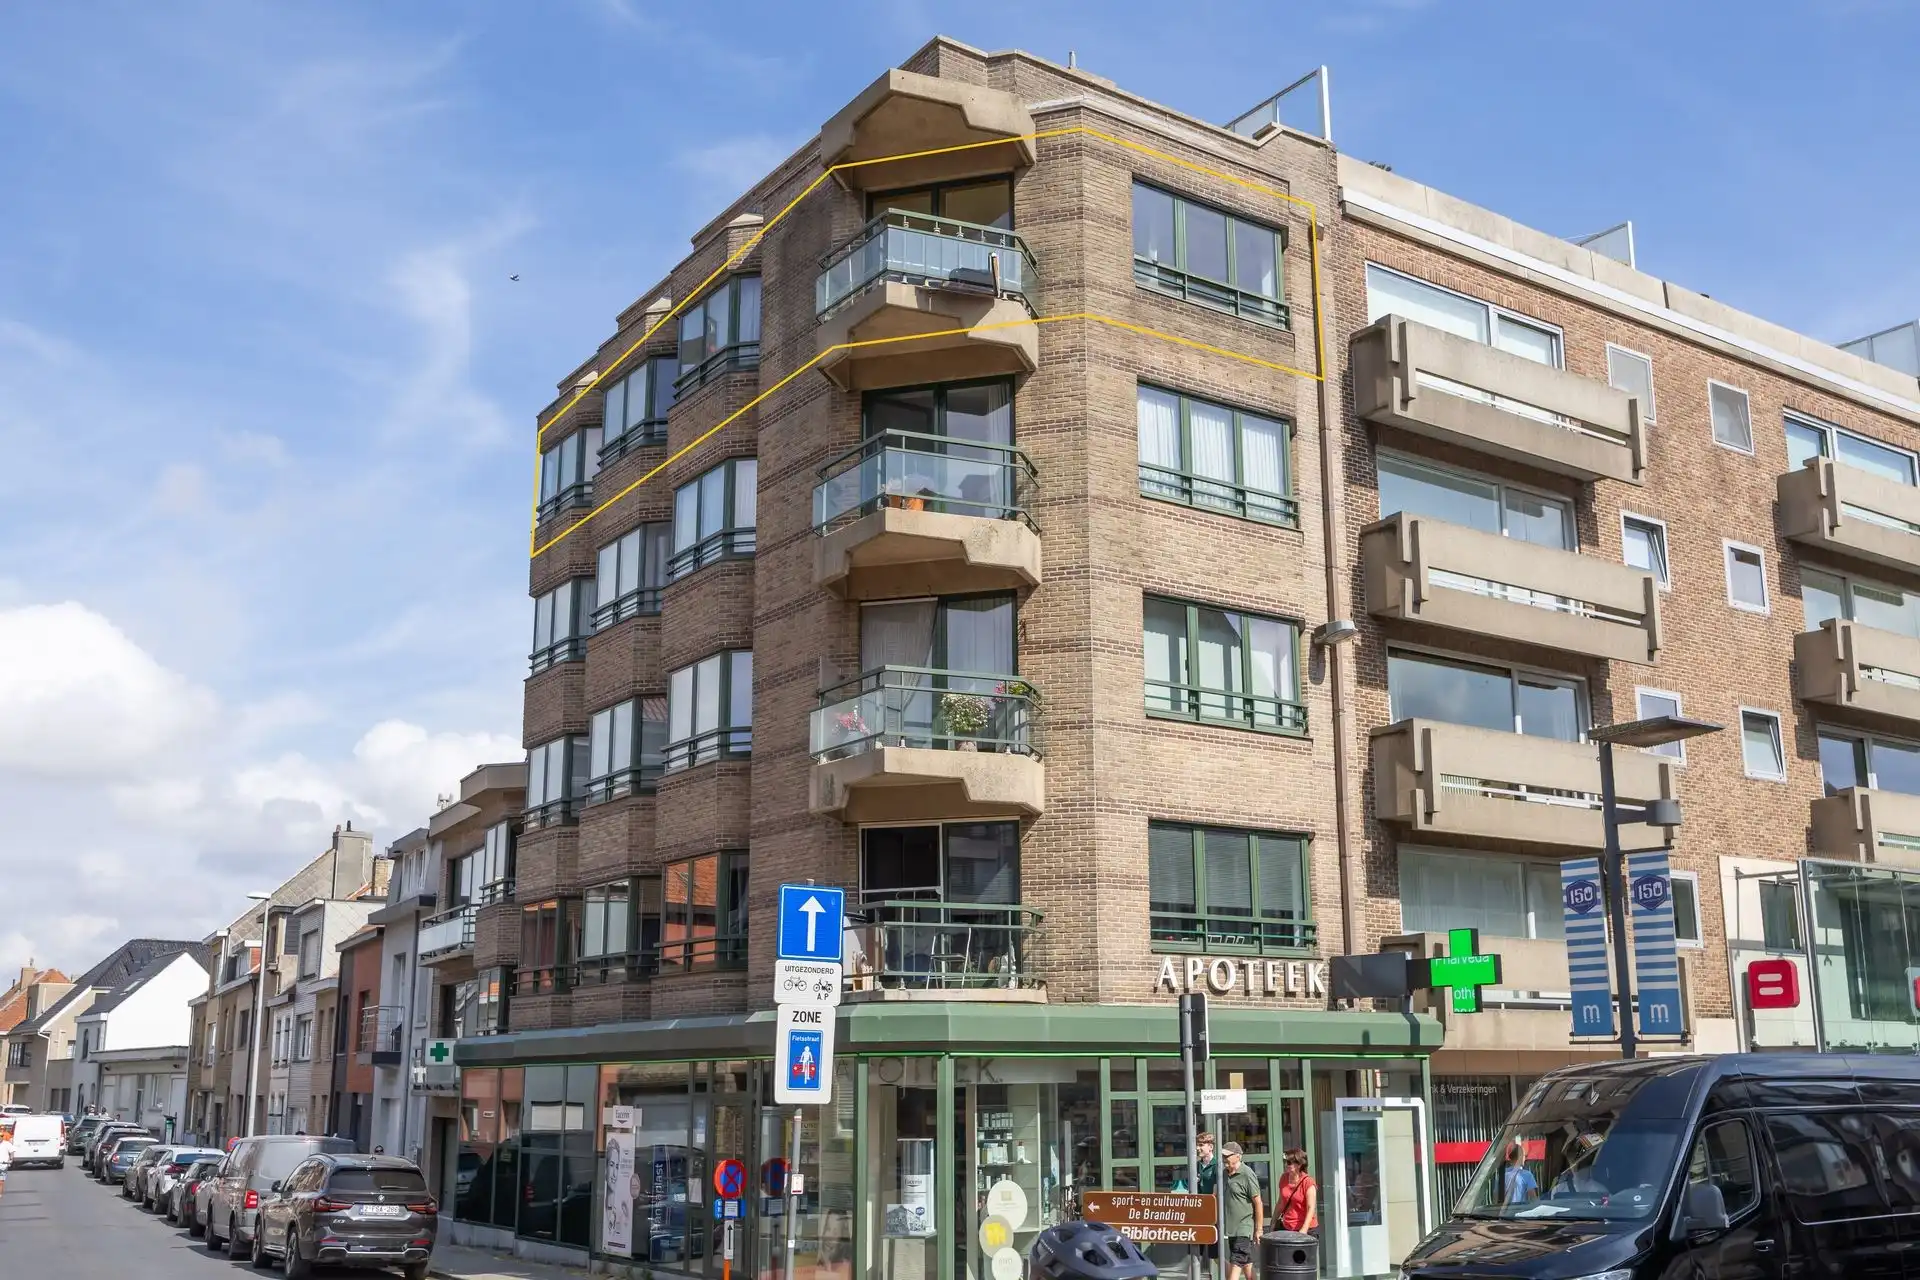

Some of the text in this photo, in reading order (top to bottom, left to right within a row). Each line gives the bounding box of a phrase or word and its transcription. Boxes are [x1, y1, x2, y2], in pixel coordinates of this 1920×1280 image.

[1570, 886, 1593, 904] 150
[1637, 881, 1663, 899] 150
[784, 965, 835, 975] UITGEZONDERD
[1154, 955, 1326, 997] APOTEEK
[792, 1011, 822, 1023] ZONE
[1440, 1084, 1447, 1094] &
[1447, 1084, 1497, 1096] Verzekeringen
[1153, 1196, 1203, 1208] cultuurhuis
[1128, 1208, 1186, 1223] De Branding
[1120, 1226, 1197, 1241] Bibliotheek
